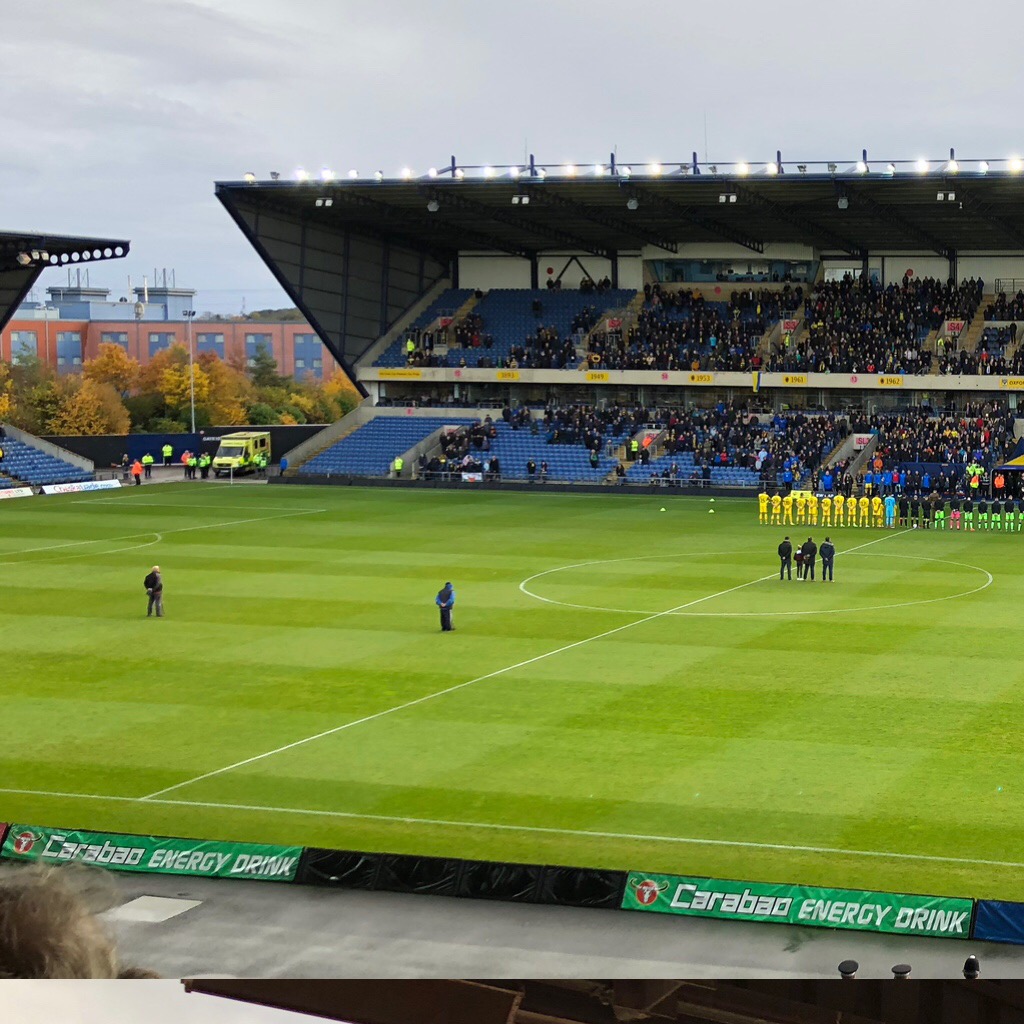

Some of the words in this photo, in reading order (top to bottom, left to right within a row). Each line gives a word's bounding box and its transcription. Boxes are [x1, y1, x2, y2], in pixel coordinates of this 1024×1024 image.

[696, 374, 710, 382] 1953
[41, 835, 146, 866] Carabao
[147, 849, 233, 874] ENERGY
[230, 854, 298, 876] DRINK
[669, 883, 793, 917] Carabao
[798, 899, 892, 927] ENERGY
[894, 906, 968, 934] DRINK
